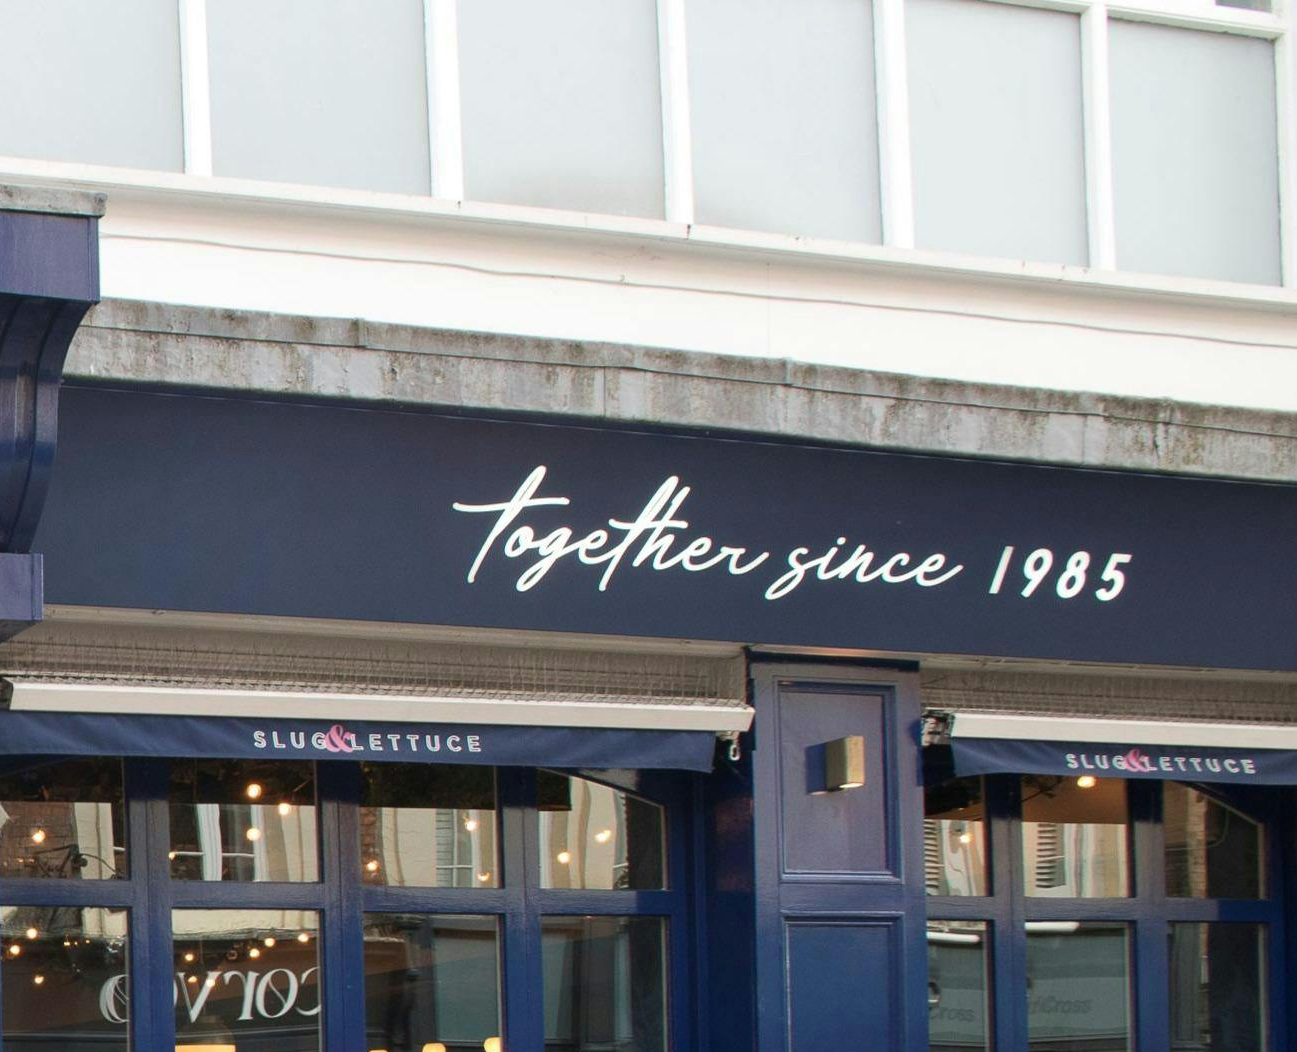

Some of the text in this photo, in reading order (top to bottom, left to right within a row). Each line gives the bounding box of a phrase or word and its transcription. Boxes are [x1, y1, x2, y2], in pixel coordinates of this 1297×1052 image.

[452, 464, 1133, 602] together since 1985
